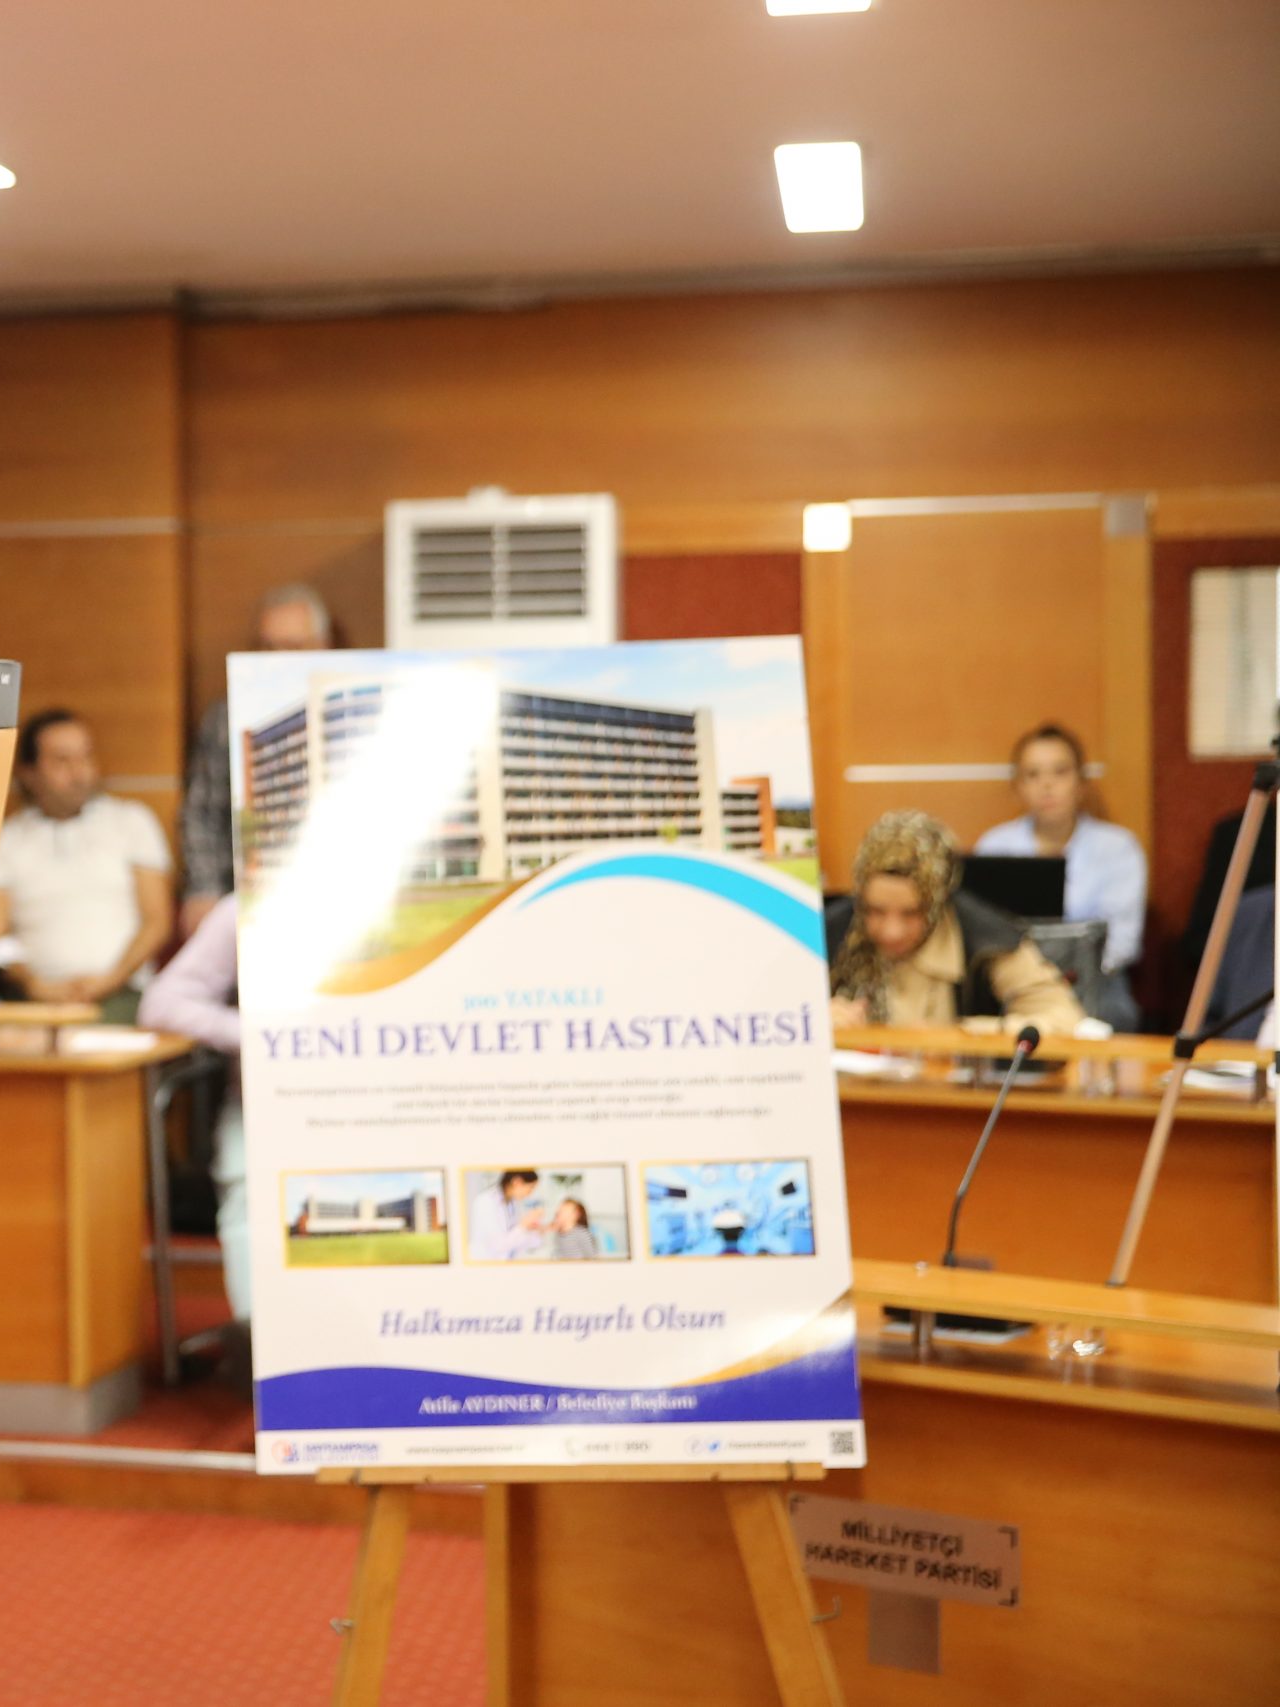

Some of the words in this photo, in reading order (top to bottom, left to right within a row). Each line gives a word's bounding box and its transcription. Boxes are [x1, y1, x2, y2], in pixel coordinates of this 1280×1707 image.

[260, 1018, 364, 1060] YENİ
[378, 1017, 552, 1058] DEVLET
[565, 1003, 816, 1053] HASTANESİ
[379, 1308, 523, 1337] Halkımıza
[532, 1305, 635, 1342] Hayırlı
[641, 1302, 727, 1332] Olsun
[557, 1391, 628, 1414] Belediye
[841, 1520, 964, 1558] MİLLİYETÇİ
[805, 1542, 908, 1574] HAREKET
[914, 1556, 1004, 1590] PARTİSİ
